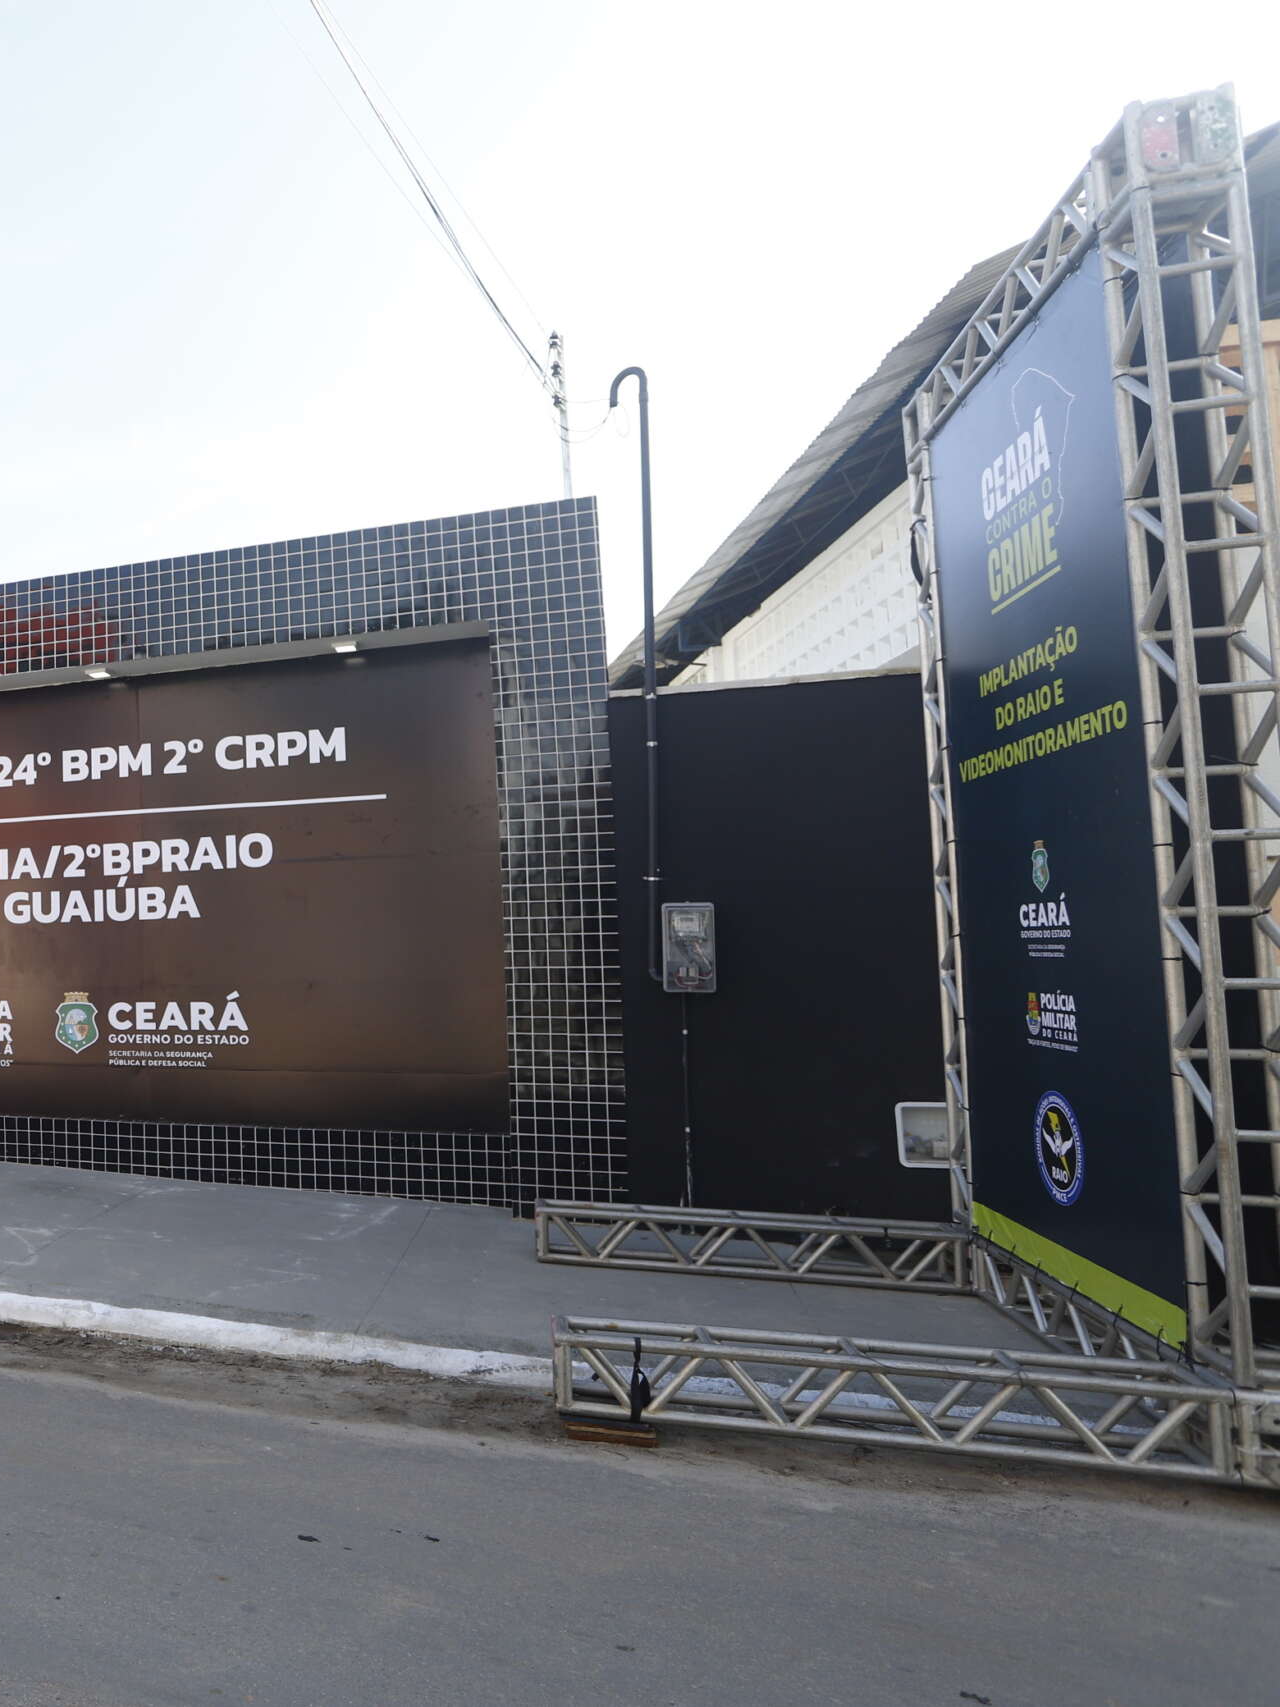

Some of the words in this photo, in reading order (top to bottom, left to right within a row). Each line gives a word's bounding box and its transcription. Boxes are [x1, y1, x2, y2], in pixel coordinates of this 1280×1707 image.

[981, 405, 1051, 521] CEARÁ
[985, 491, 1038, 544] CONTRA
[1041, 477, 1052, 499] O
[988, 503, 1058, 602] CRIME
[979, 626, 1078, 697] IMPLANTAÇÃO
[994, 702, 1015, 731] DO
[1016, 685, 1051, 722] RAIO
[1053, 678, 1065, 706] E
[62, 743, 152, 782] BPM
[163, 739, 204, 775] 2º
[214, 727, 347, 770] CRPM
[959, 700, 1128, 783] VIDEOMONITORAMENTO
[4, 876, 201, 925] GUAIÚBA
[1020, 892, 1070, 927] CEARÁ
[1021, 930, 1042, 938] GOVERNO
[1043, 930, 1051, 938] DO
[1051, 929, 1071, 938] ESTADO
[108, 990, 249, 1031] CEARÁ
[1040, 990, 1076, 1012] POLÍCIA
[108, 1034, 171, 1044] GOVERNO
[174, 1034, 194, 1045] DO
[197, 1034, 250, 1045] ESTADO
[1041, 1011, 1077, 1031] MILITAR
[1042, 1028, 1052, 1038] DO
[1054, 1030, 1078, 1042] CEARÁ
[109, 1057, 140, 1066] PÚBLICA
[166, 1050, 213, 1060] SEGURANÇA
[1051, 1166, 1068, 1183] RAIO
